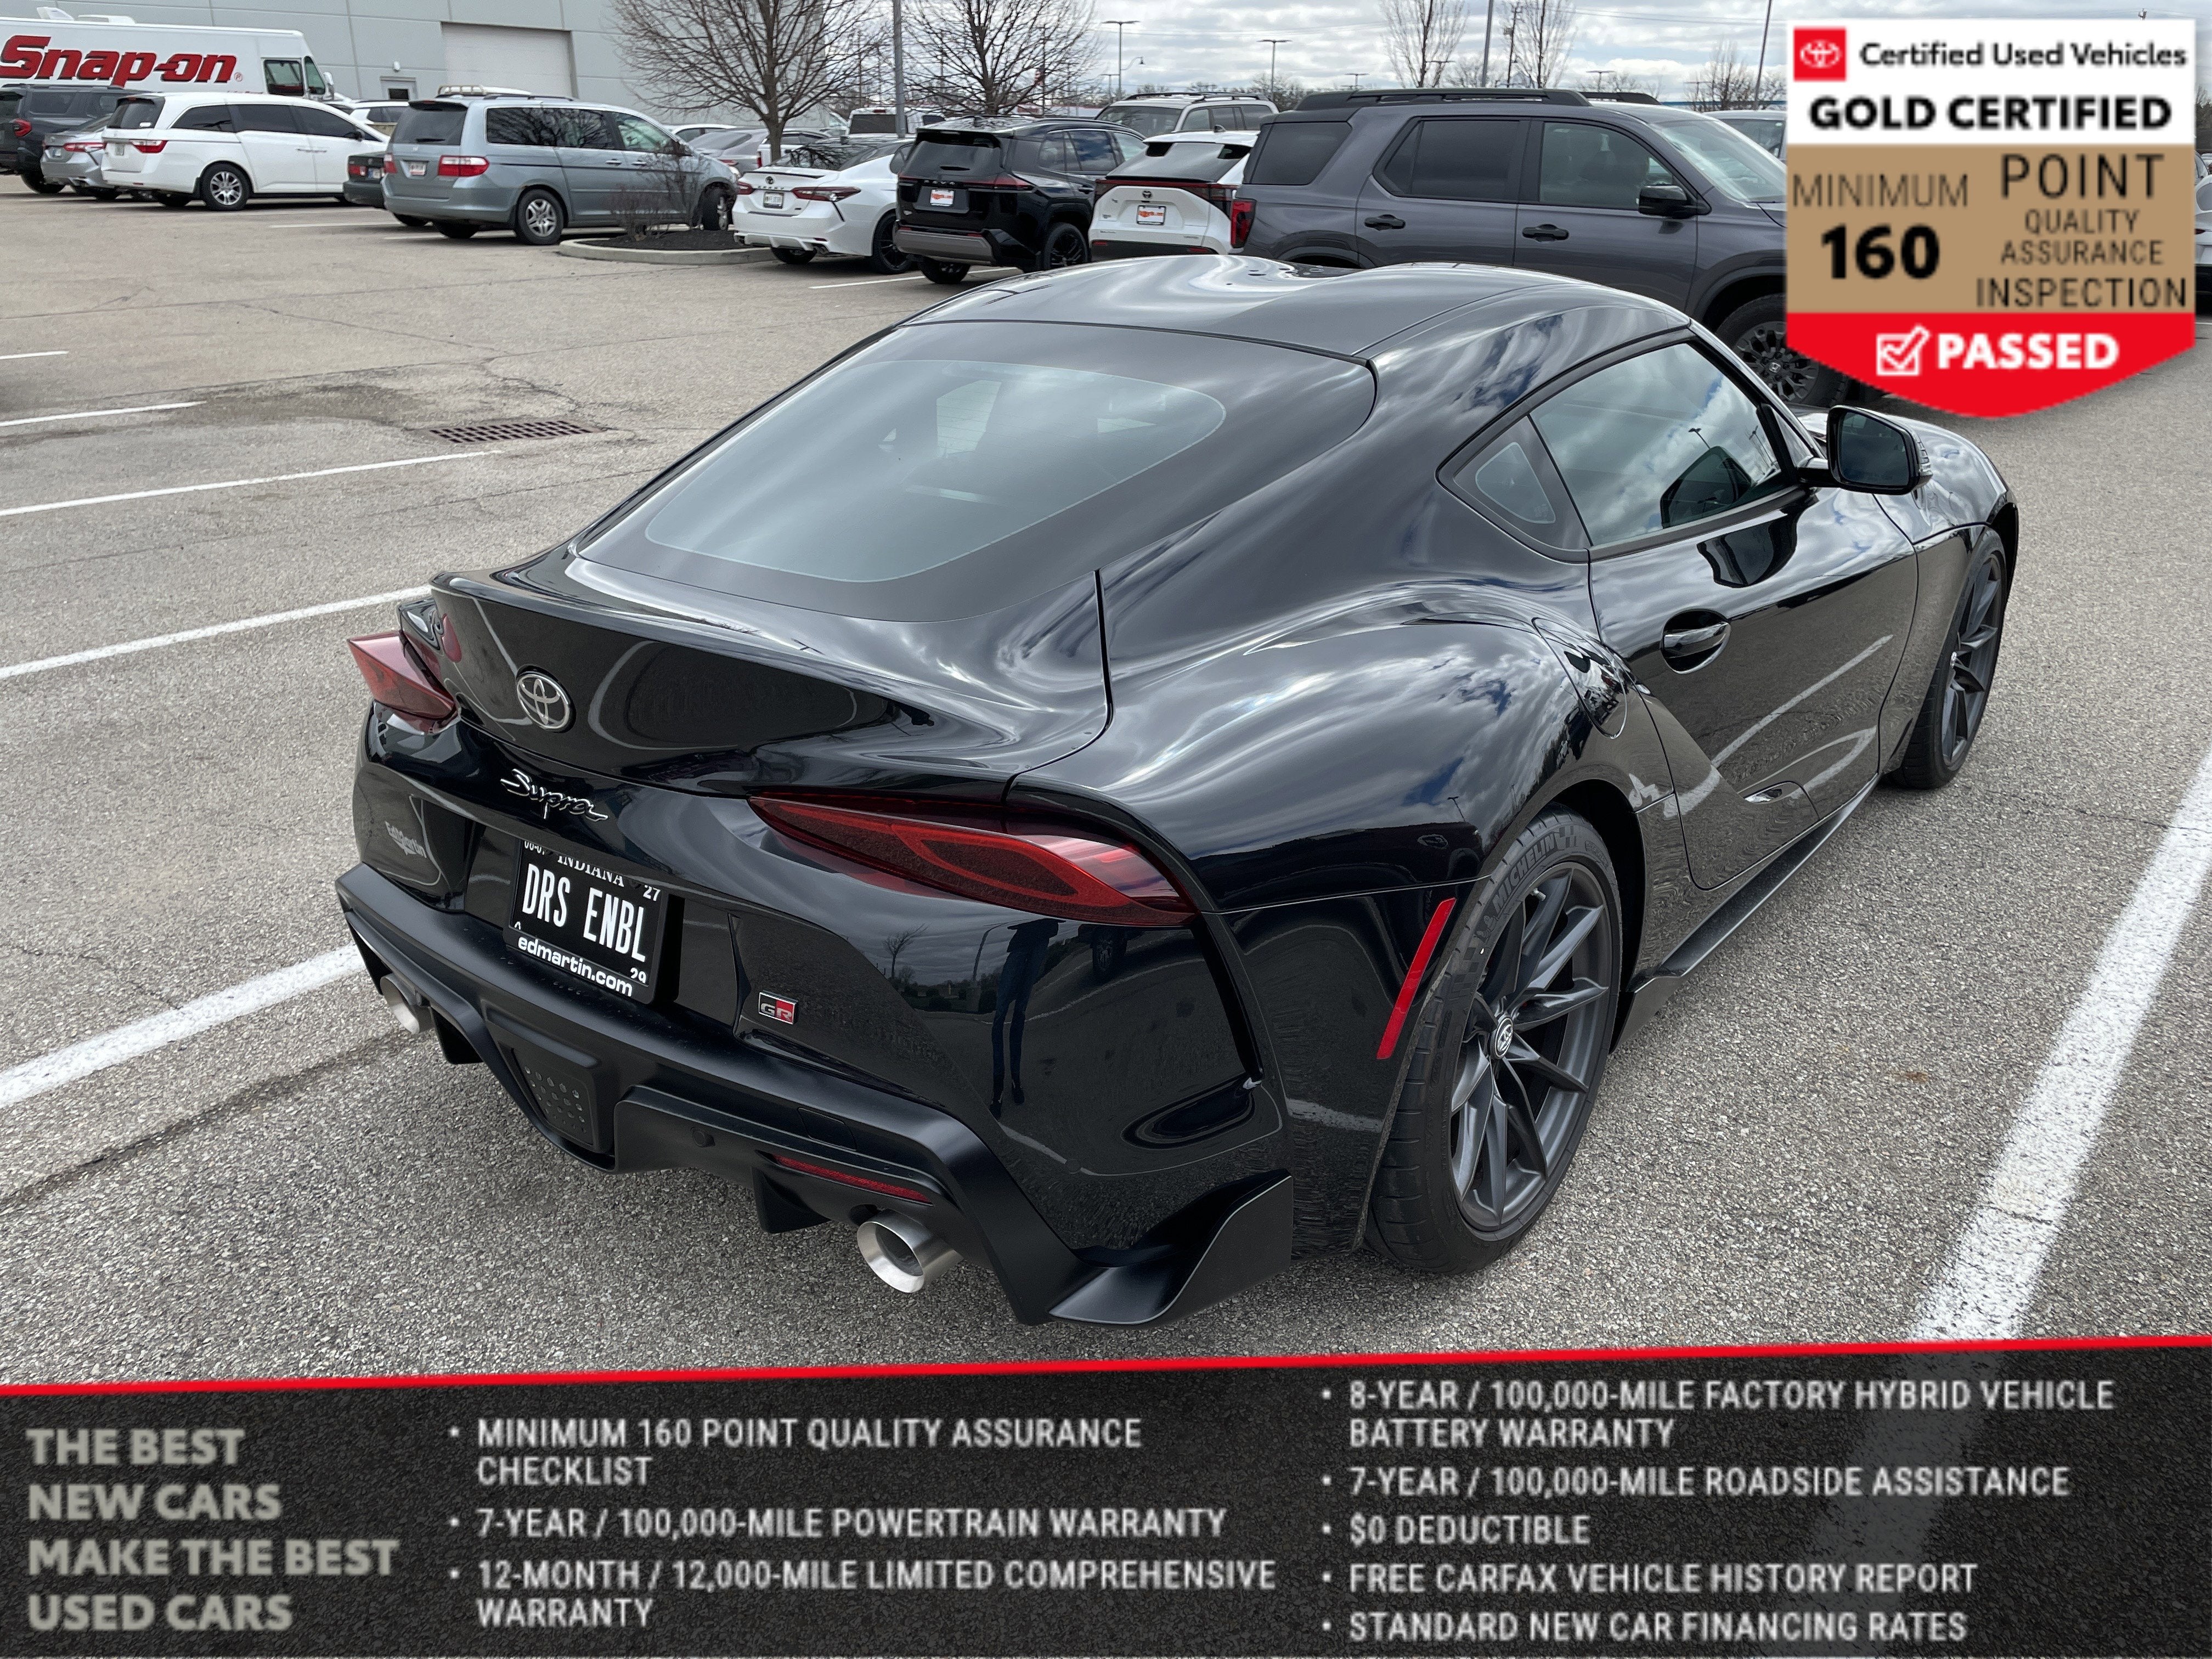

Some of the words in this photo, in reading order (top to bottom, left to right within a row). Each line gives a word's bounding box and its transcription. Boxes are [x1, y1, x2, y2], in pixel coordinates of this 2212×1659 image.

[0, 35, 237, 88] Snap-on
[500, 769, 608, 822] Supra
[557, 855, 624, 887] INDIANA
[643, 884, 661, 901] 27
[1491, 832, 1556, 914] MICHELIN
[522, 863, 571, 927] DRS
[583, 887, 646, 962] ENBL
[518, 936, 633, 997] edmartin.com
[630, 967, 646, 984] 29
[760, 1003, 792, 1022] GR
